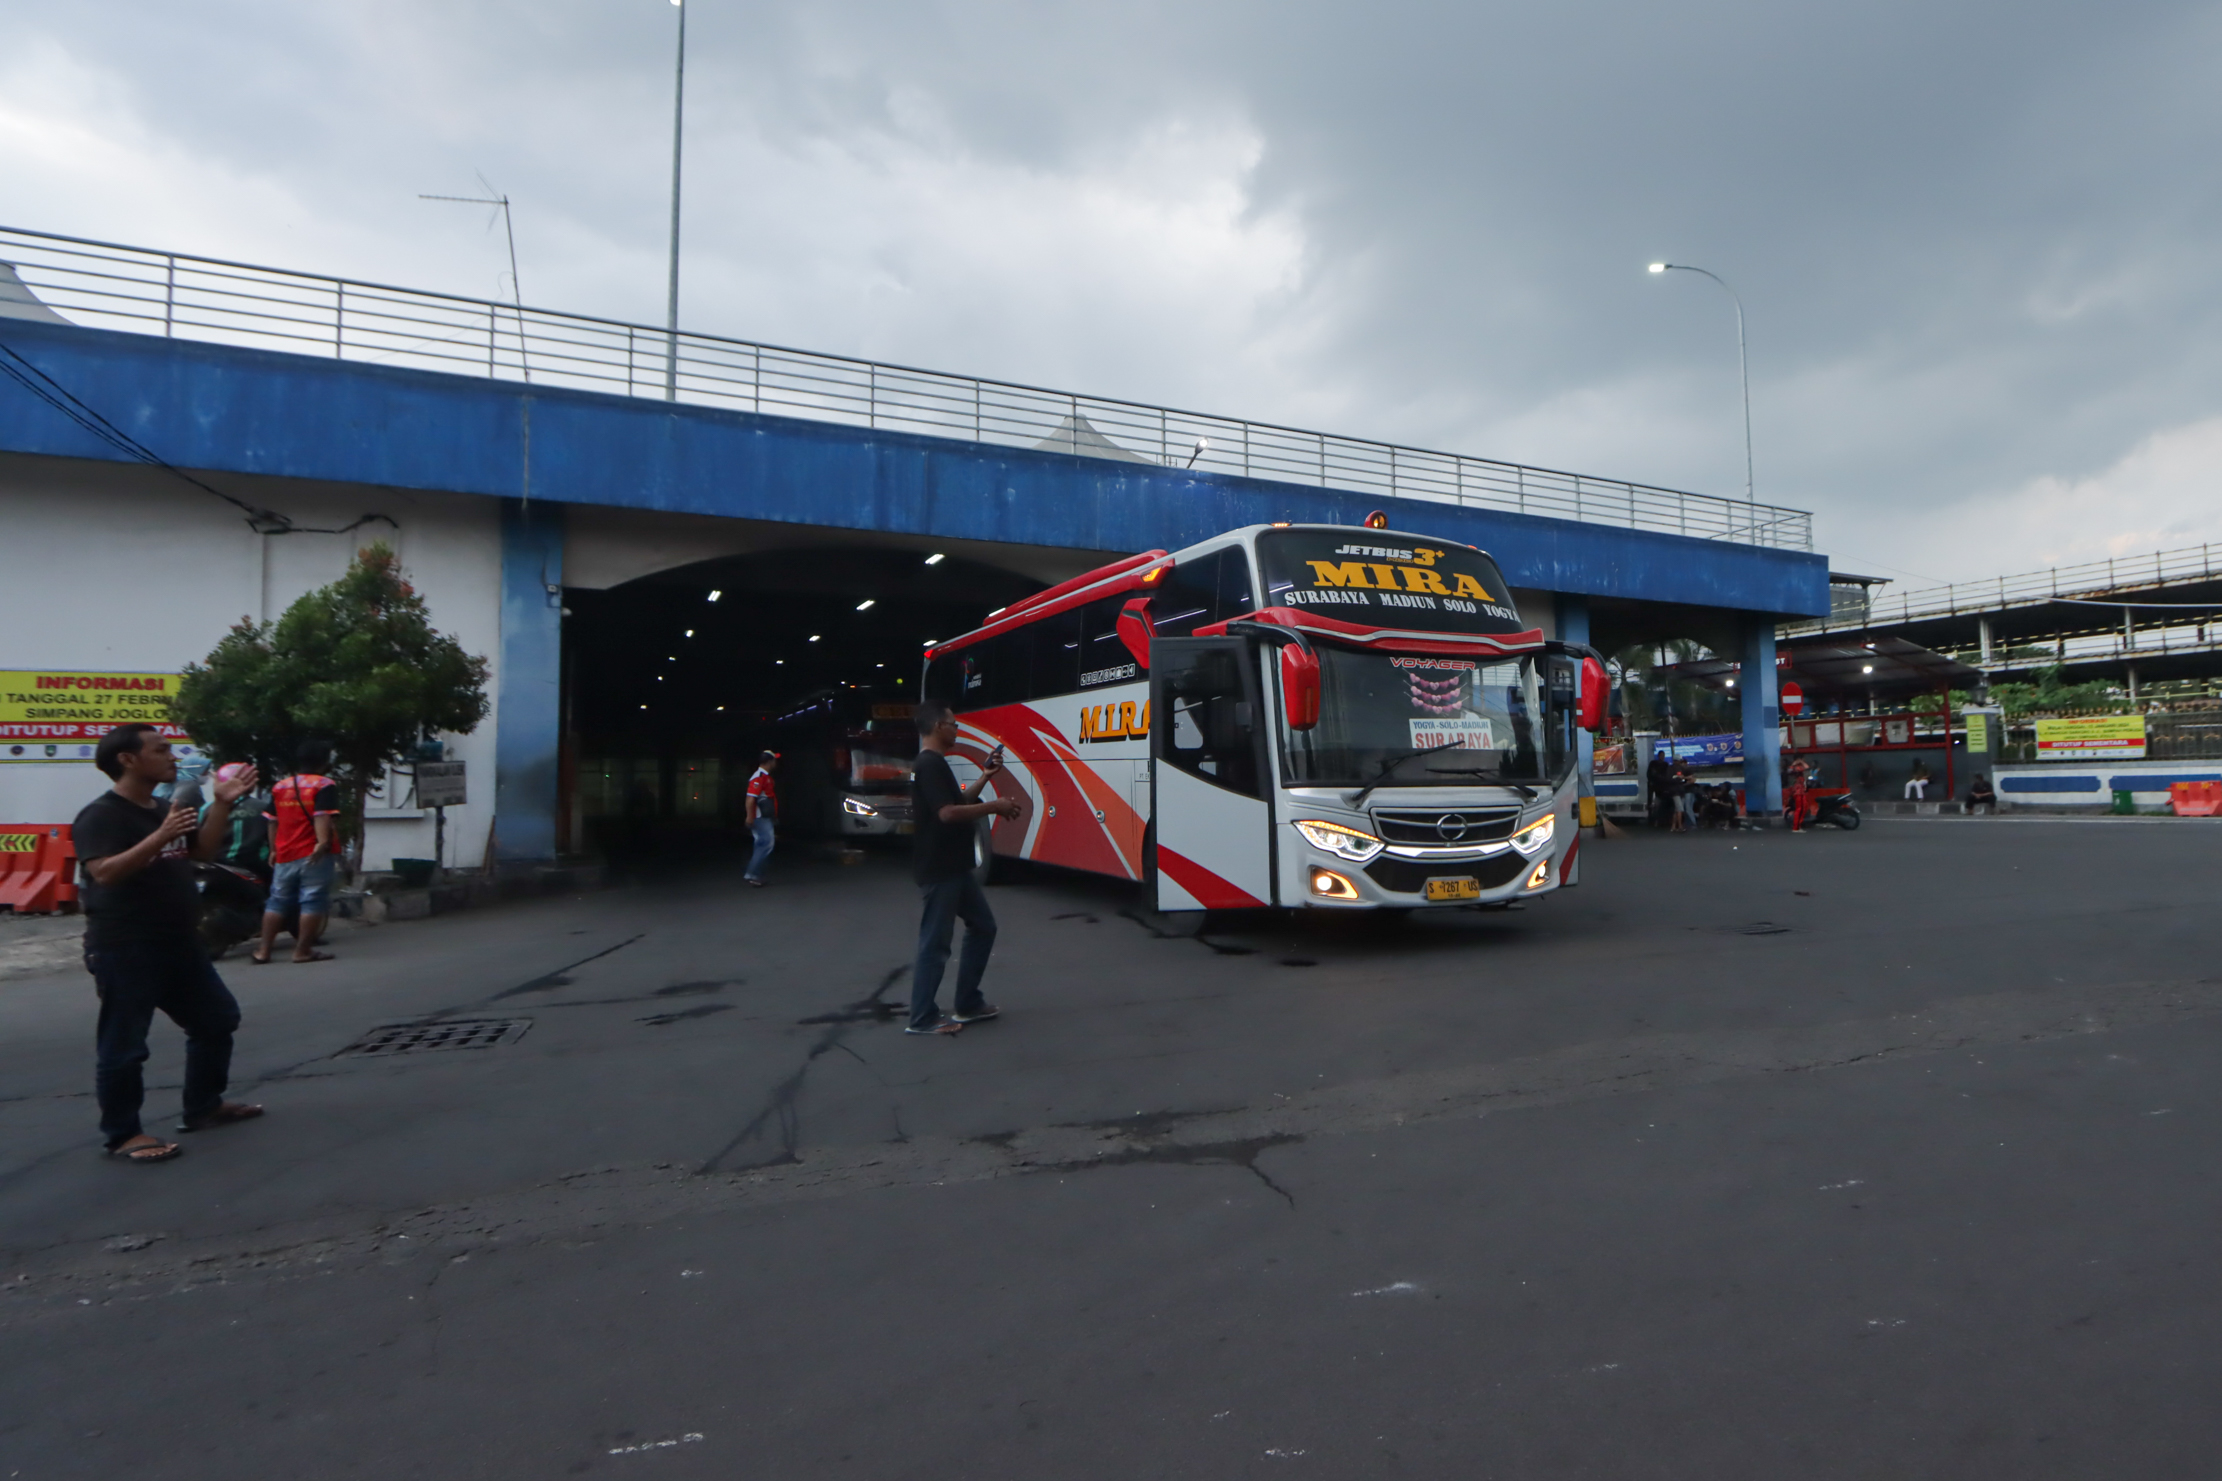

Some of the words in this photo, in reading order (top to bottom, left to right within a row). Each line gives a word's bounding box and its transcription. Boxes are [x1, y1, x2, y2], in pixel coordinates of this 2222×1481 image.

[1335, 545, 1413, 559] JETBUS
[1305, 560, 1496, 602] MIRA
[1284, 590, 1371, 606] SURABAYA
[1379, 593, 1437, 610] MADIUN
[1443, 598, 1477, 614] SOLO
[1482, 603, 1522, 623] YOGYA
[1390, 657, 1476, 671] VOYAGER
[36, 676, 165, 691] INFORMASI
[6, 693, 89, 704] TANGGAL
[95, 694, 112, 705] 27
[25, 707, 104, 719] SIMPANG
[108, 708, 168, 720] JOGLO
[0, 724, 79, 736] ITUTUP
[1415, 732, 1491, 749] SURABAYA
[1428, 882, 1434, 893] S
[1467, 880, 1478, 892] US
